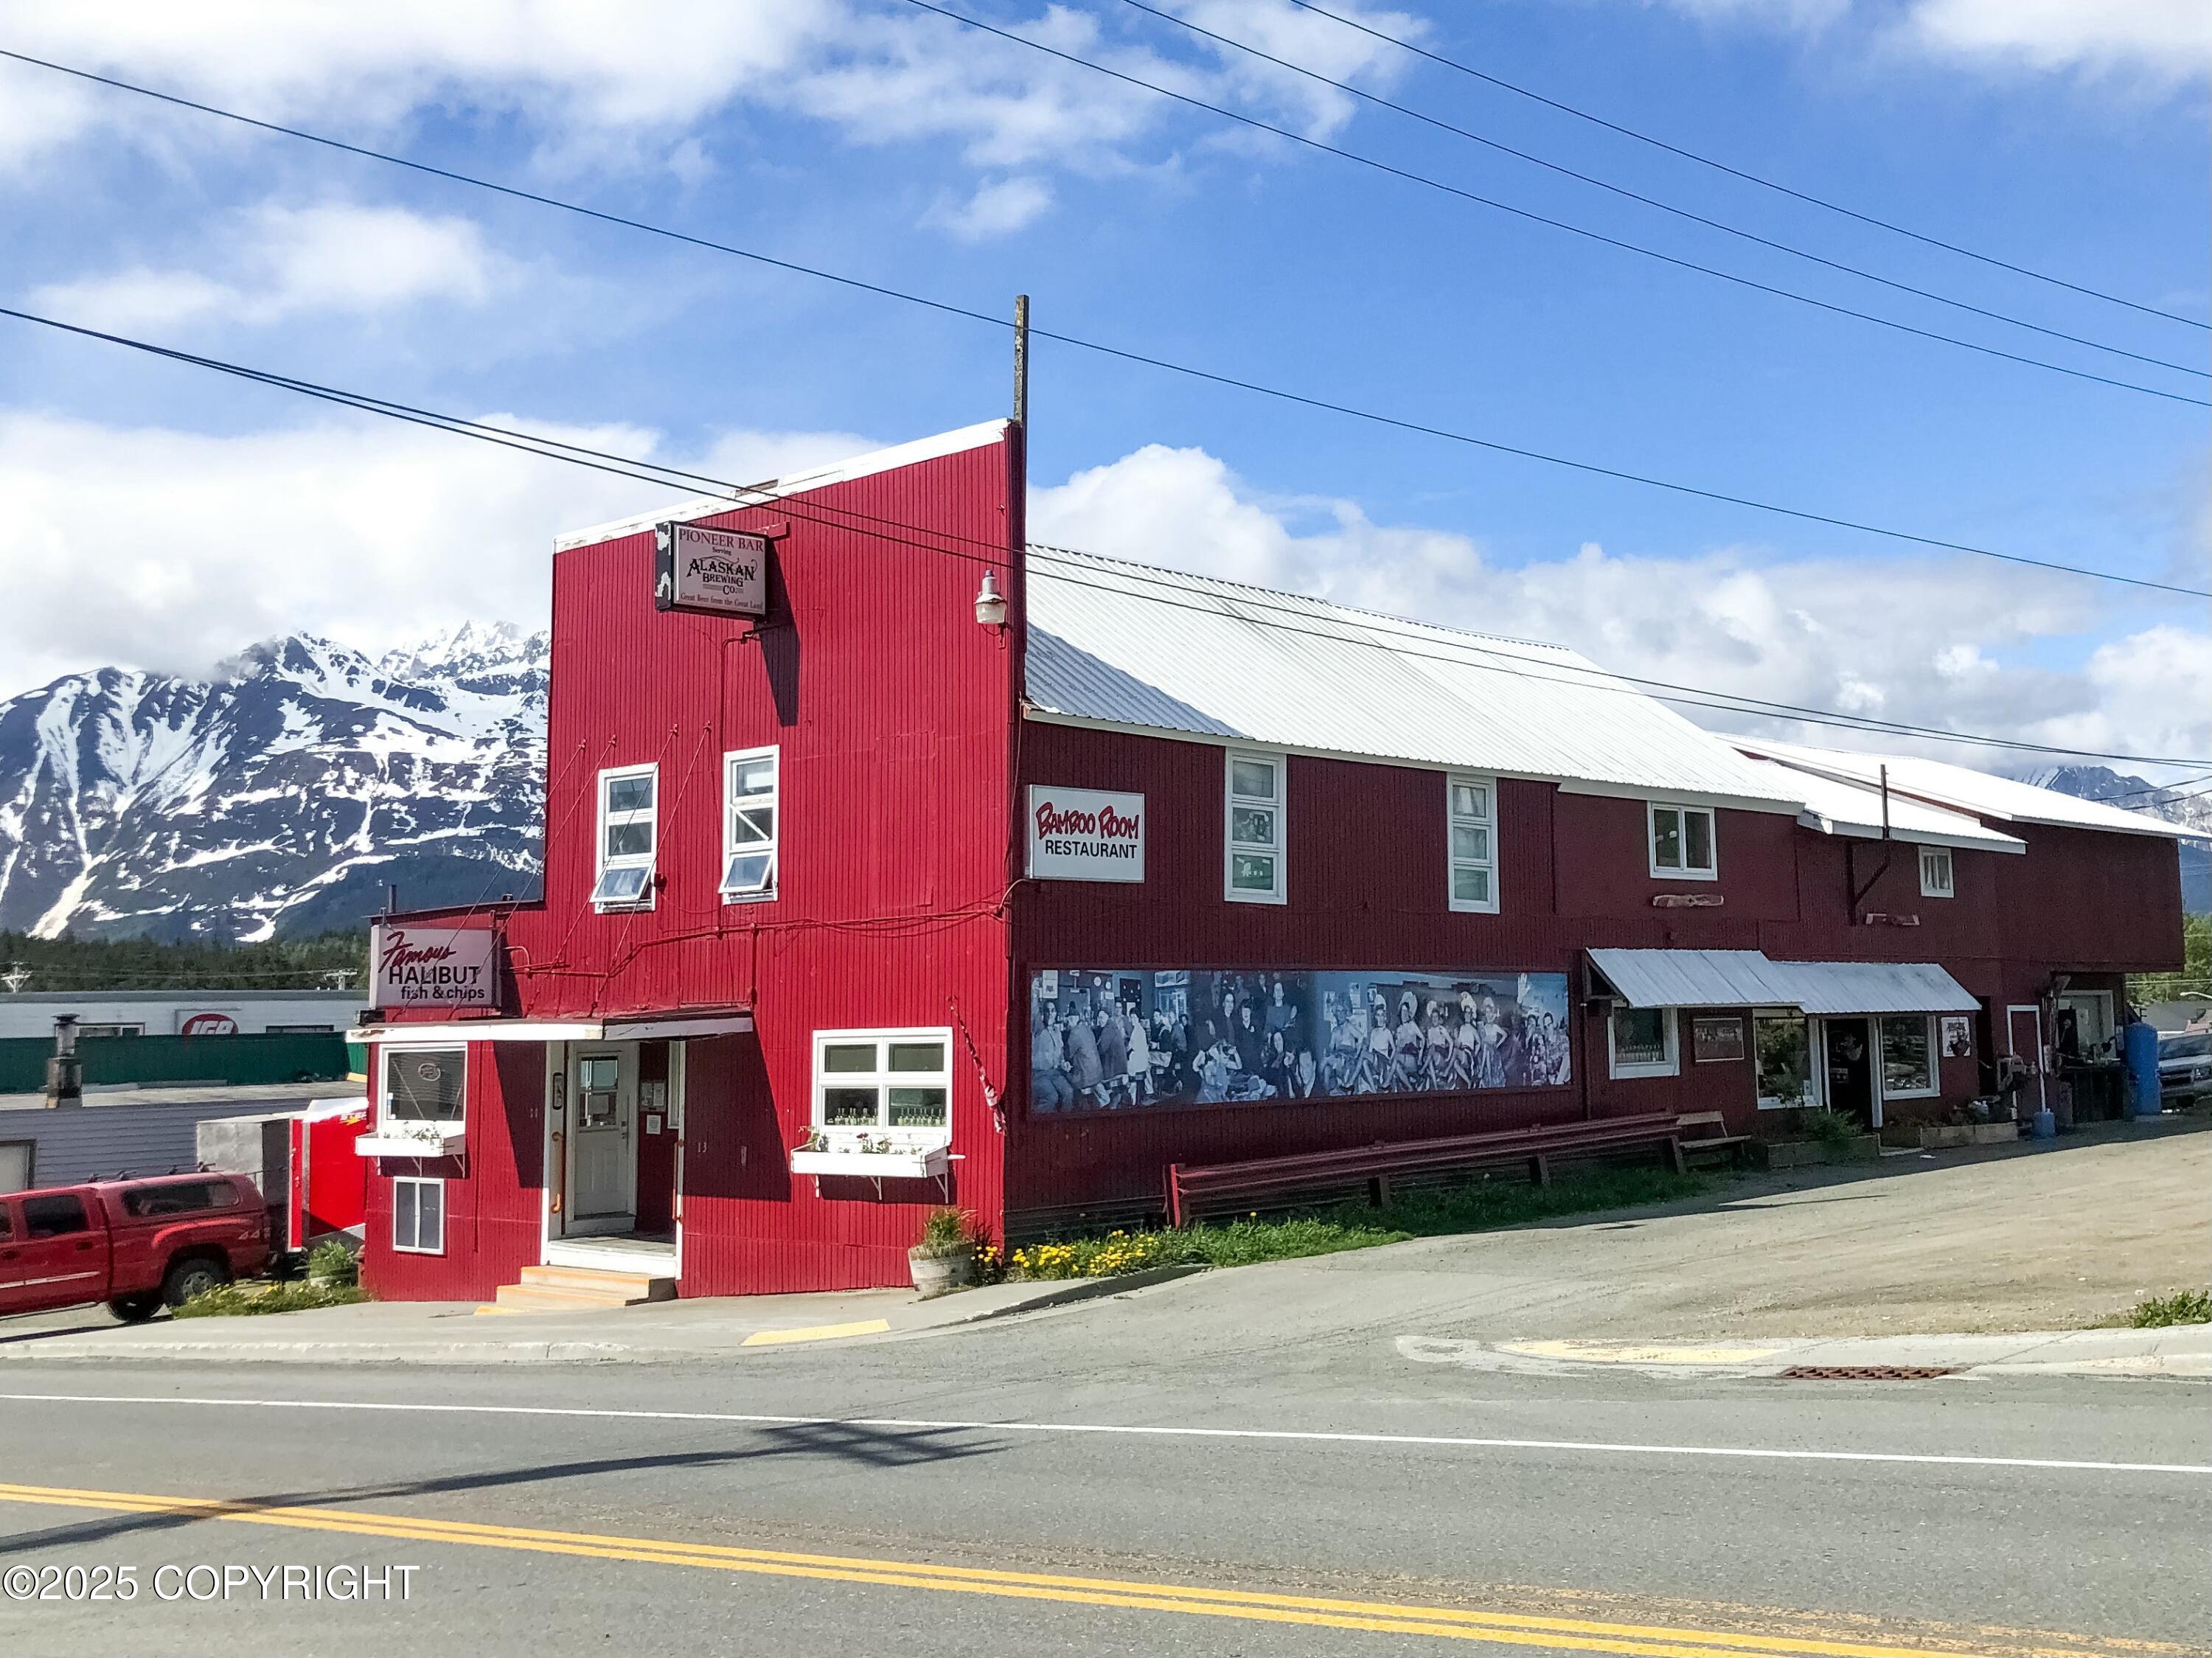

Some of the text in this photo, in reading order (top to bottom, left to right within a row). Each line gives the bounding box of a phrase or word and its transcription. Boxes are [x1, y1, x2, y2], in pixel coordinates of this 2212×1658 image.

[679, 529, 764, 552] PIONEER BAR
[712, 546, 732, 556] Serving
[686, 557, 757, 581] ALASKAN
[703, 573, 744, 587] BREWING
[681, 593, 695, 601] Great
[710, 595, 723, 604] from
[724, 597, 733, 605] the
[734, 599, 748, 607] Great
[1045, 839, 1138, 859] RESTAURANT
[378, 931, 457, 974] Famous
[389, 966, 481, 985] HALIBUT
[400, 985, 485, 1002] fish & chips
